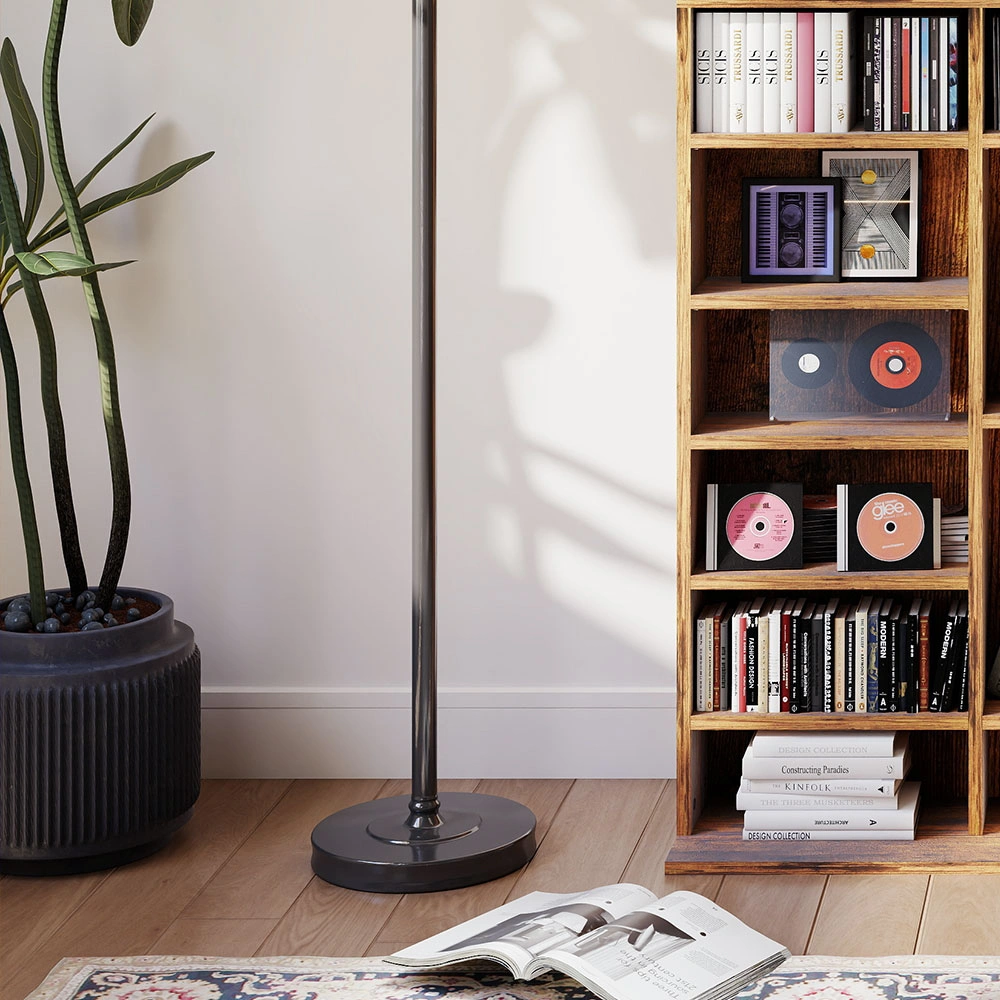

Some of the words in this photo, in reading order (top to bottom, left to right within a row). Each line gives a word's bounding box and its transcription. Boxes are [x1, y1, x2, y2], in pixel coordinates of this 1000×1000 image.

[697, 49, 711, 85] SICIS
[714, 49, 727, 85] SICIS
[733, 29, 743, 82] TRUSSARDI
[748, 49, 761, 85] SICIS
[765, 49, 778, 85] SICIS
[784, 29, 793, 82] TRUSSARDI
[816, 49, 829, 85] SICIS
[835, 29, 844, 82] TRUSSARDI
[871, 501, 905, 521] glee
[940, 621, 953, 659] MODERN
[778, 746, 812, 754] DESIGN
[813, 746, 868, 754] COLLECTION
[781, 766, 822, 776] Constructing
[822, 765, 850, 774] Paradies
[784, 783, 832, 792] KINFOLK
[748, 832, 772, 840] DESIGN
[773, 832, 811, 840] COLLECTION
[652, 982, 680, 999] Three
